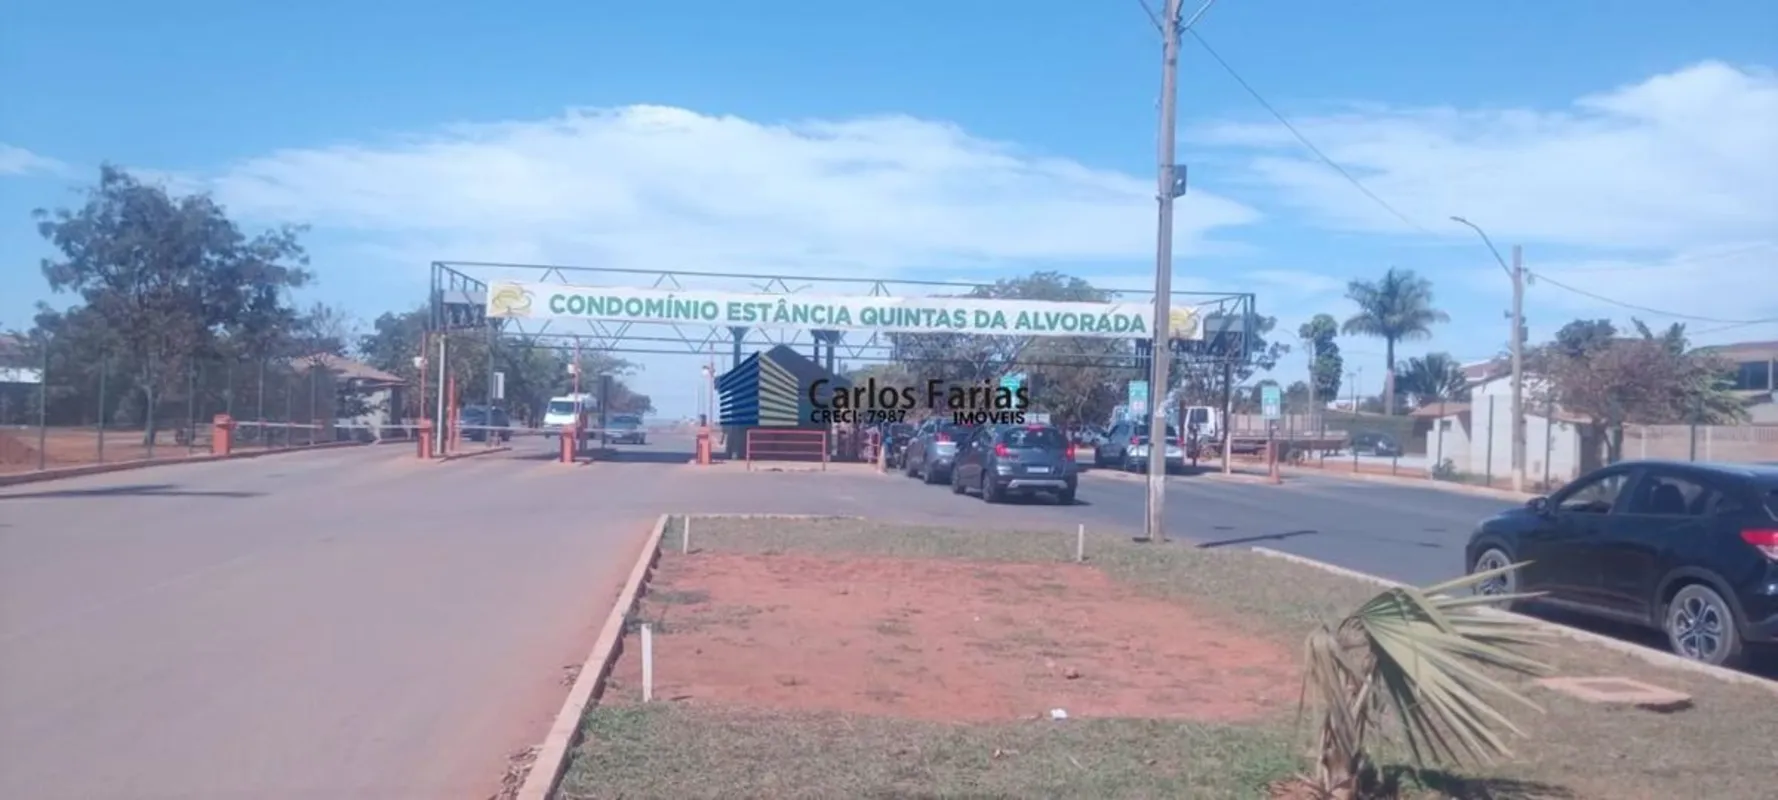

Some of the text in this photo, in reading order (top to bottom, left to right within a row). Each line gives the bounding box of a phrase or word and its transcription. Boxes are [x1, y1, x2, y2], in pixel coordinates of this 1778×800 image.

[549, 294, 1146, 333] CONDOMÍNIO ESTÂNCIA QUINTAS DA ALVORADA
